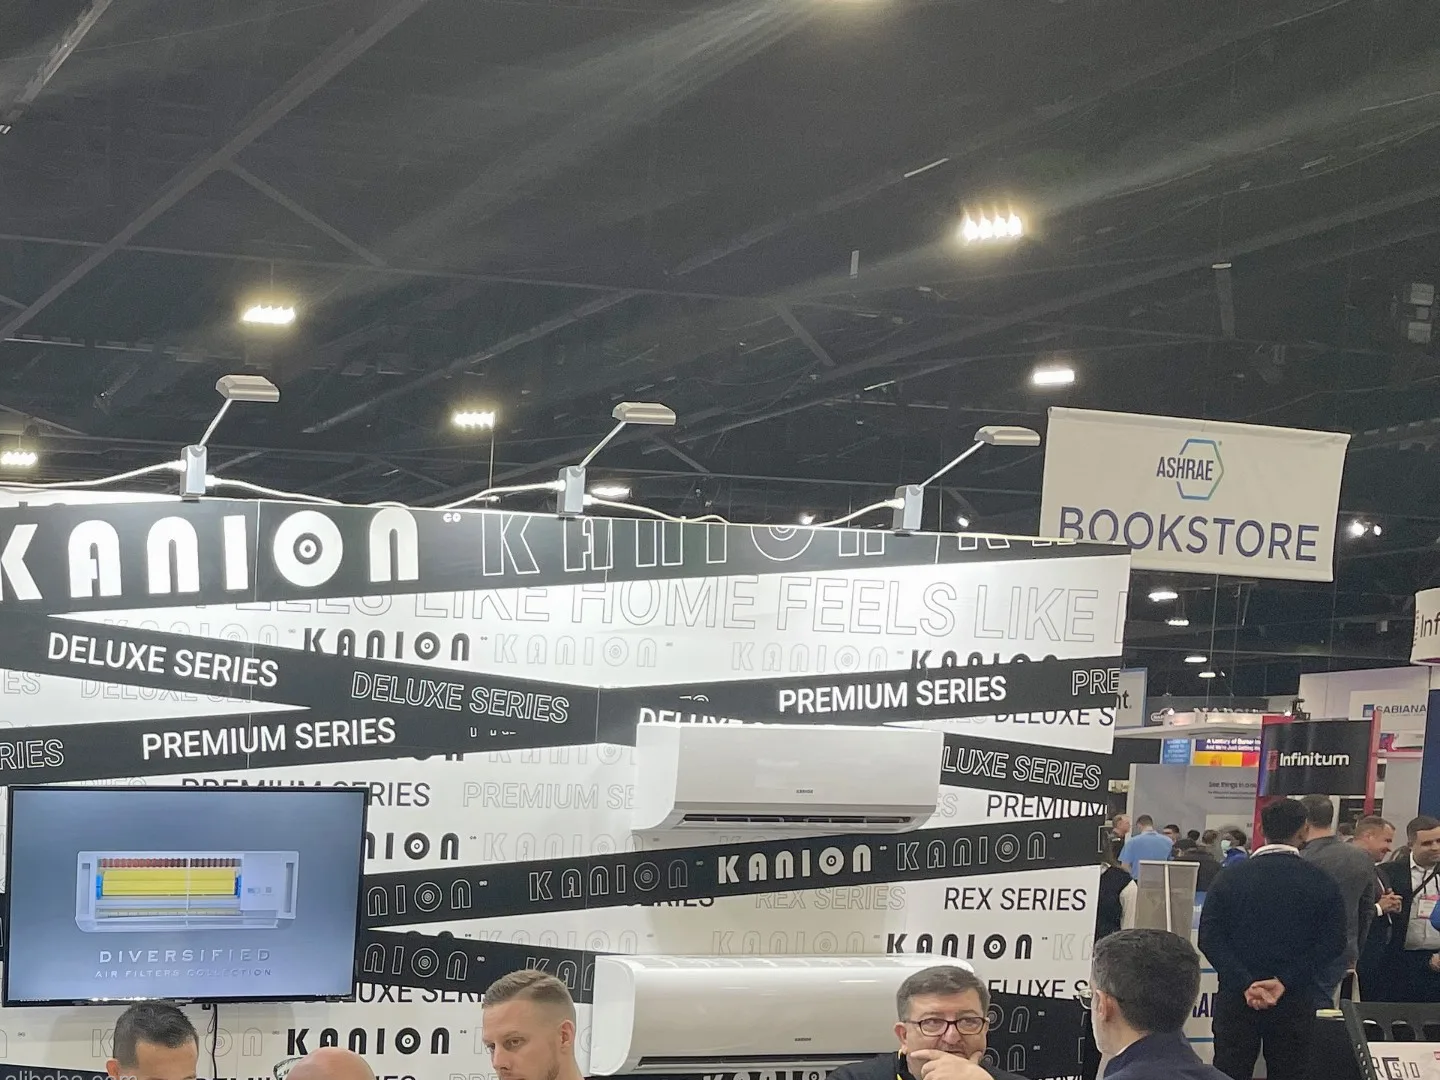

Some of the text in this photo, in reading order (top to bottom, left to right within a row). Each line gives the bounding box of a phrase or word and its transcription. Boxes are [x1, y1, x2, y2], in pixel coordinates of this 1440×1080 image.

[1156, 456, 1214, 481] ASHRAE
[1059, 507, 1319, 561] BOOKSTORE
[777, 576, 957, 637] FEELS
[974, 584, 1099, 642] LIKE
[49, 632, 166, 674] DELUXE
[174, 649, 279, 688] SERIES
[304, 627, 471, 662] KANION
[351, 671, 570, 724] DELUXE SERIES
[778, 682, 907, 715] PREMIUM
[915, 675, 1007, 707] SERIES
[143, 717, 396, 762] PREMIUM SERIES
[1014, 755, 1102, 790] SERIES
[1280, 752, 1349, 767] Infinitum
[718, 831, 1048, 885] KANION KANION
[528, 860, 689, 903] KANION
[944, 887, 993, 912] REX
[1000, 887, 1088, 912] SERIES
[99, 947, 273, 964] DIVERSIFIED
[887, 931, 1033, 961] KANION
[95, 968, 273, 978] AIR FILTERS COLLECTION
[286, 1026, 450, 1057] KANION
